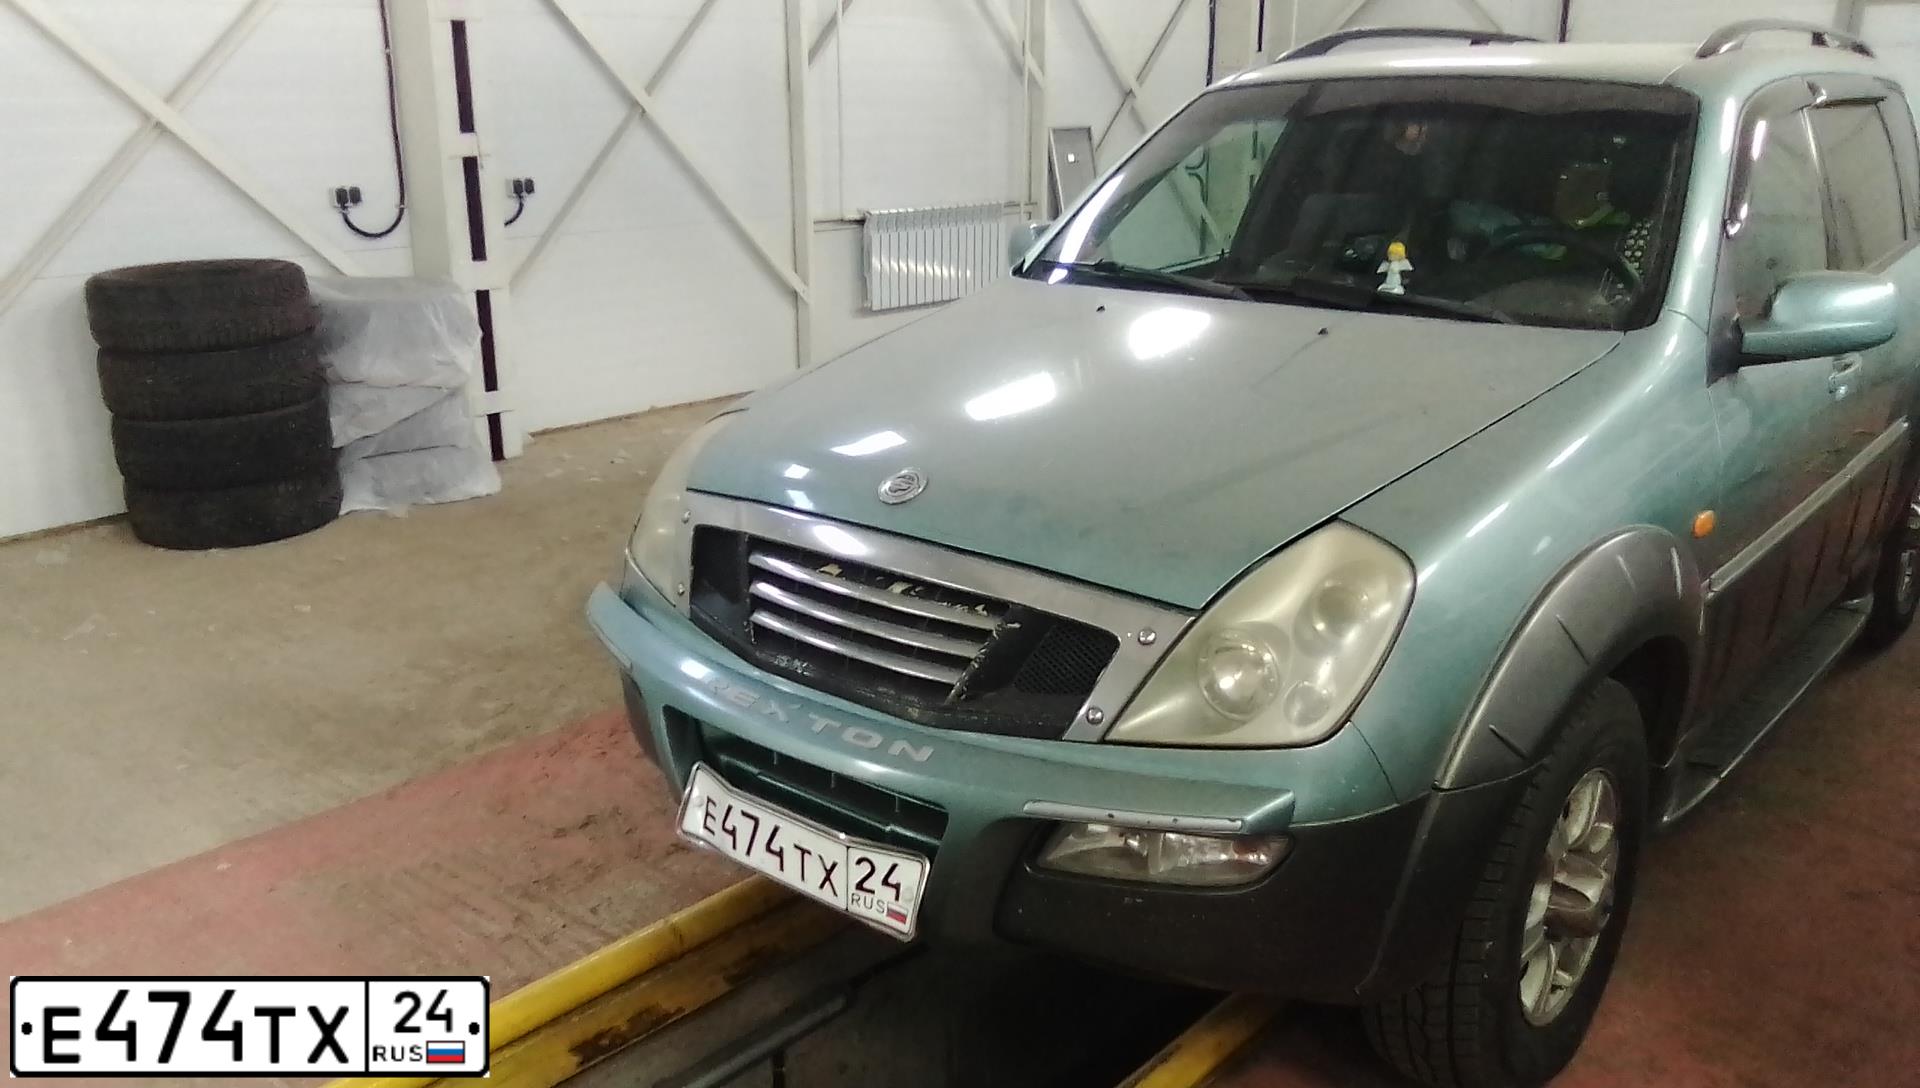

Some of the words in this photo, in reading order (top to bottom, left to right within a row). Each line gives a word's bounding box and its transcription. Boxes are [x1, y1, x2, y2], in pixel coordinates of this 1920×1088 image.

[702, 795, 839, 898] E474TX
[853, 856, 902, 903] 24
[850, 892, 886, 915] RUS
